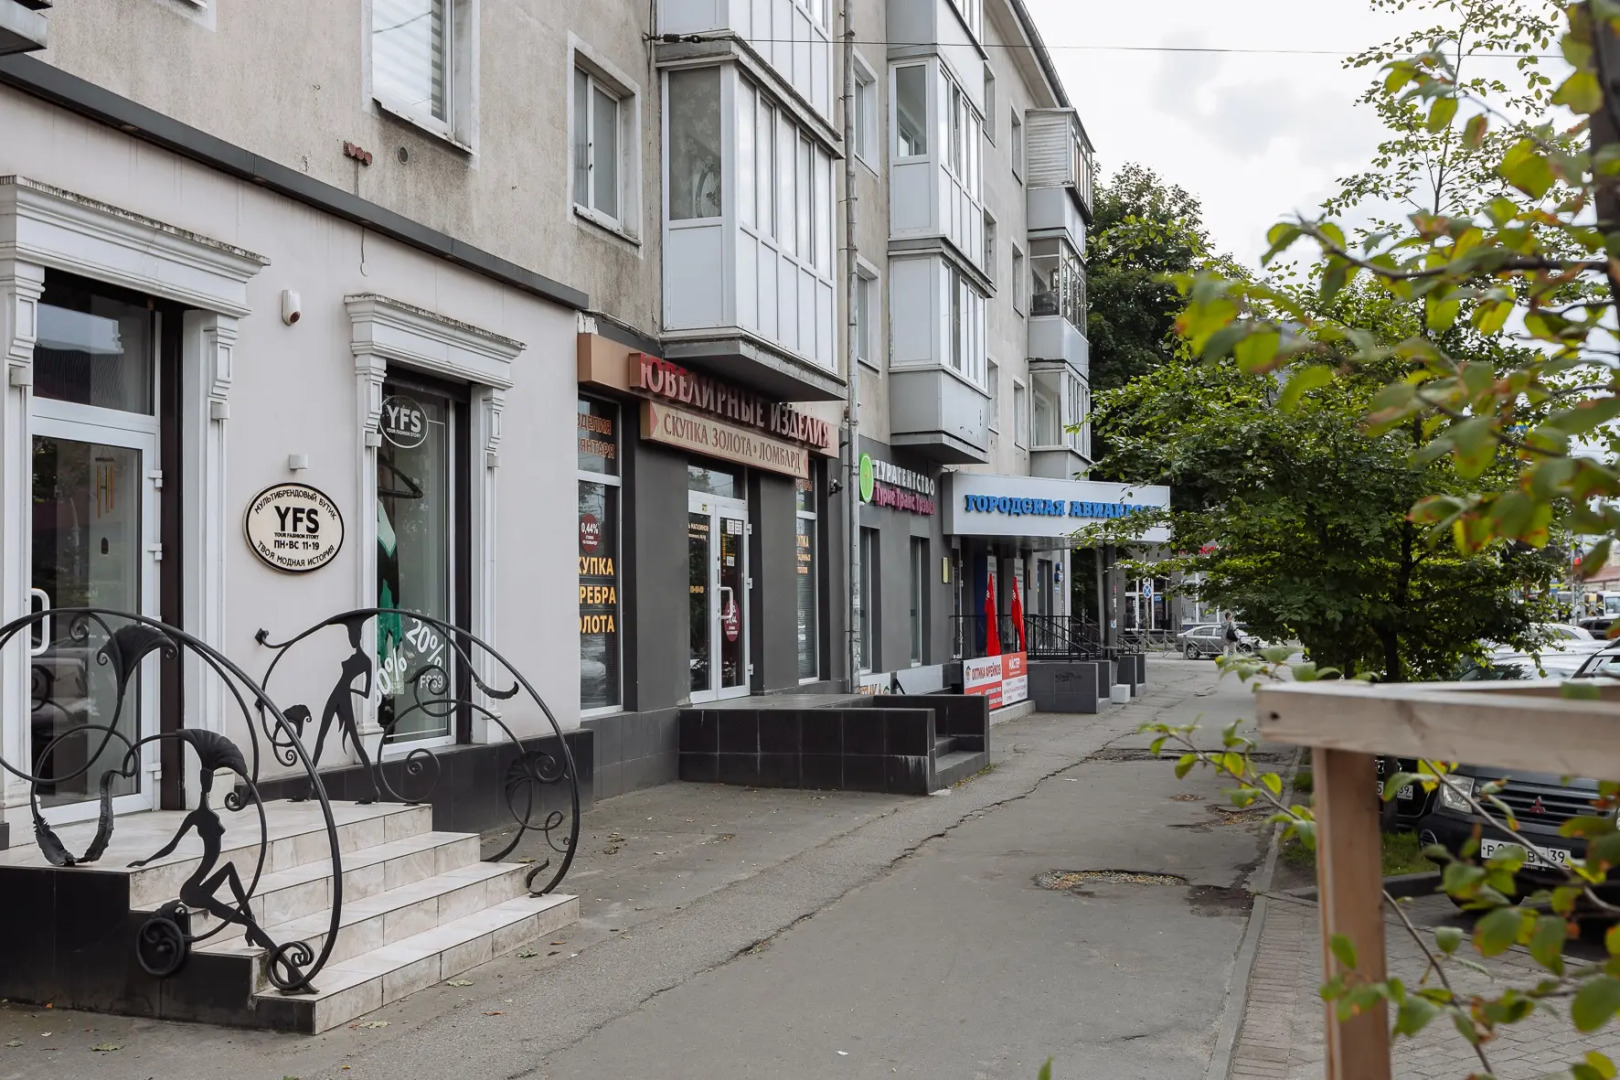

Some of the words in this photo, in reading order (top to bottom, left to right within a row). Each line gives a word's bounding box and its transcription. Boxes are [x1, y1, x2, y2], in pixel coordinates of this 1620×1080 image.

[640, 354, 765, 428] ЮВЕЛИРНЫЕ
[770, 402, 830, 448] ИЗДЕЛИЯ
[386, 404, 421, 433] YFS
[579, 437, 616, 460] ЯНТАРЯ
[663, 412, 709, 447] СКУПКА
[711, 426, 753, 457] ЗОЛОТА
[759, 441, 802, 474] ЛОМБАРД
[872, 459, 935, 497] ТУРАГЕНТСТВО
[254, 489, 317, 514] МУЛЬТИБРЕНДОВЫЙ
[318, 498, 337, 521] БУТИК
[274, 505, 320, 534] YFS
[965, 494, 1066, 517] ГОРОДСКАЯ
[258, 540, 275, 560] ТВОЯ
[276, 554, 306, 567] МОДНАЯ
[307, 544, 335, 567] ИСТОРИЯ
[405, 617, 445, 671] 20%
